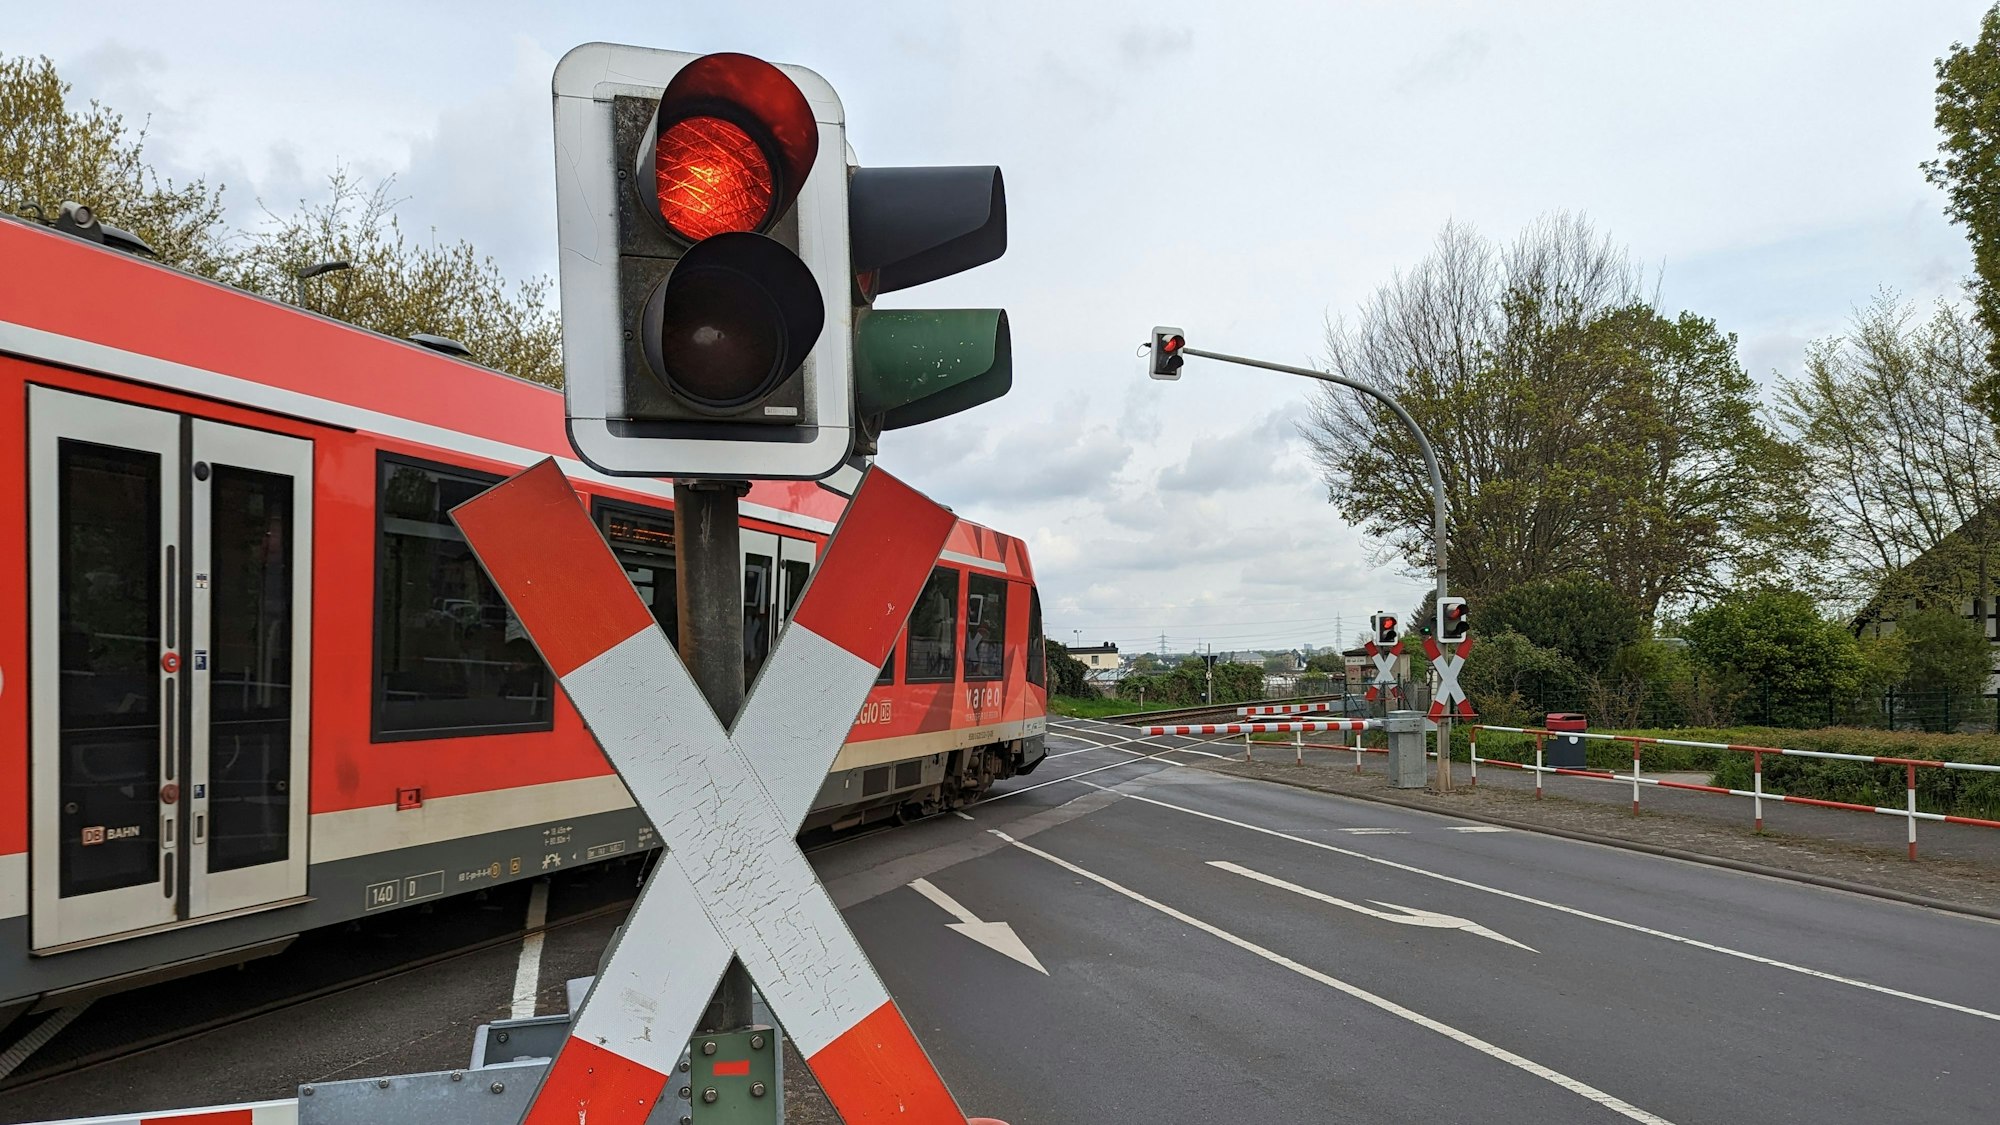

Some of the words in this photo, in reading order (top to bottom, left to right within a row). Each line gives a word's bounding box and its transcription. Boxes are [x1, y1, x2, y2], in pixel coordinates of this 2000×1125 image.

[966, 687, 1000, 709] vareo
[83, 827, 103, 844] DB
[106, 826, 140, 840] BAHN
[372, 885, 394, 904] 140
[409, 880, 416, 897] D
